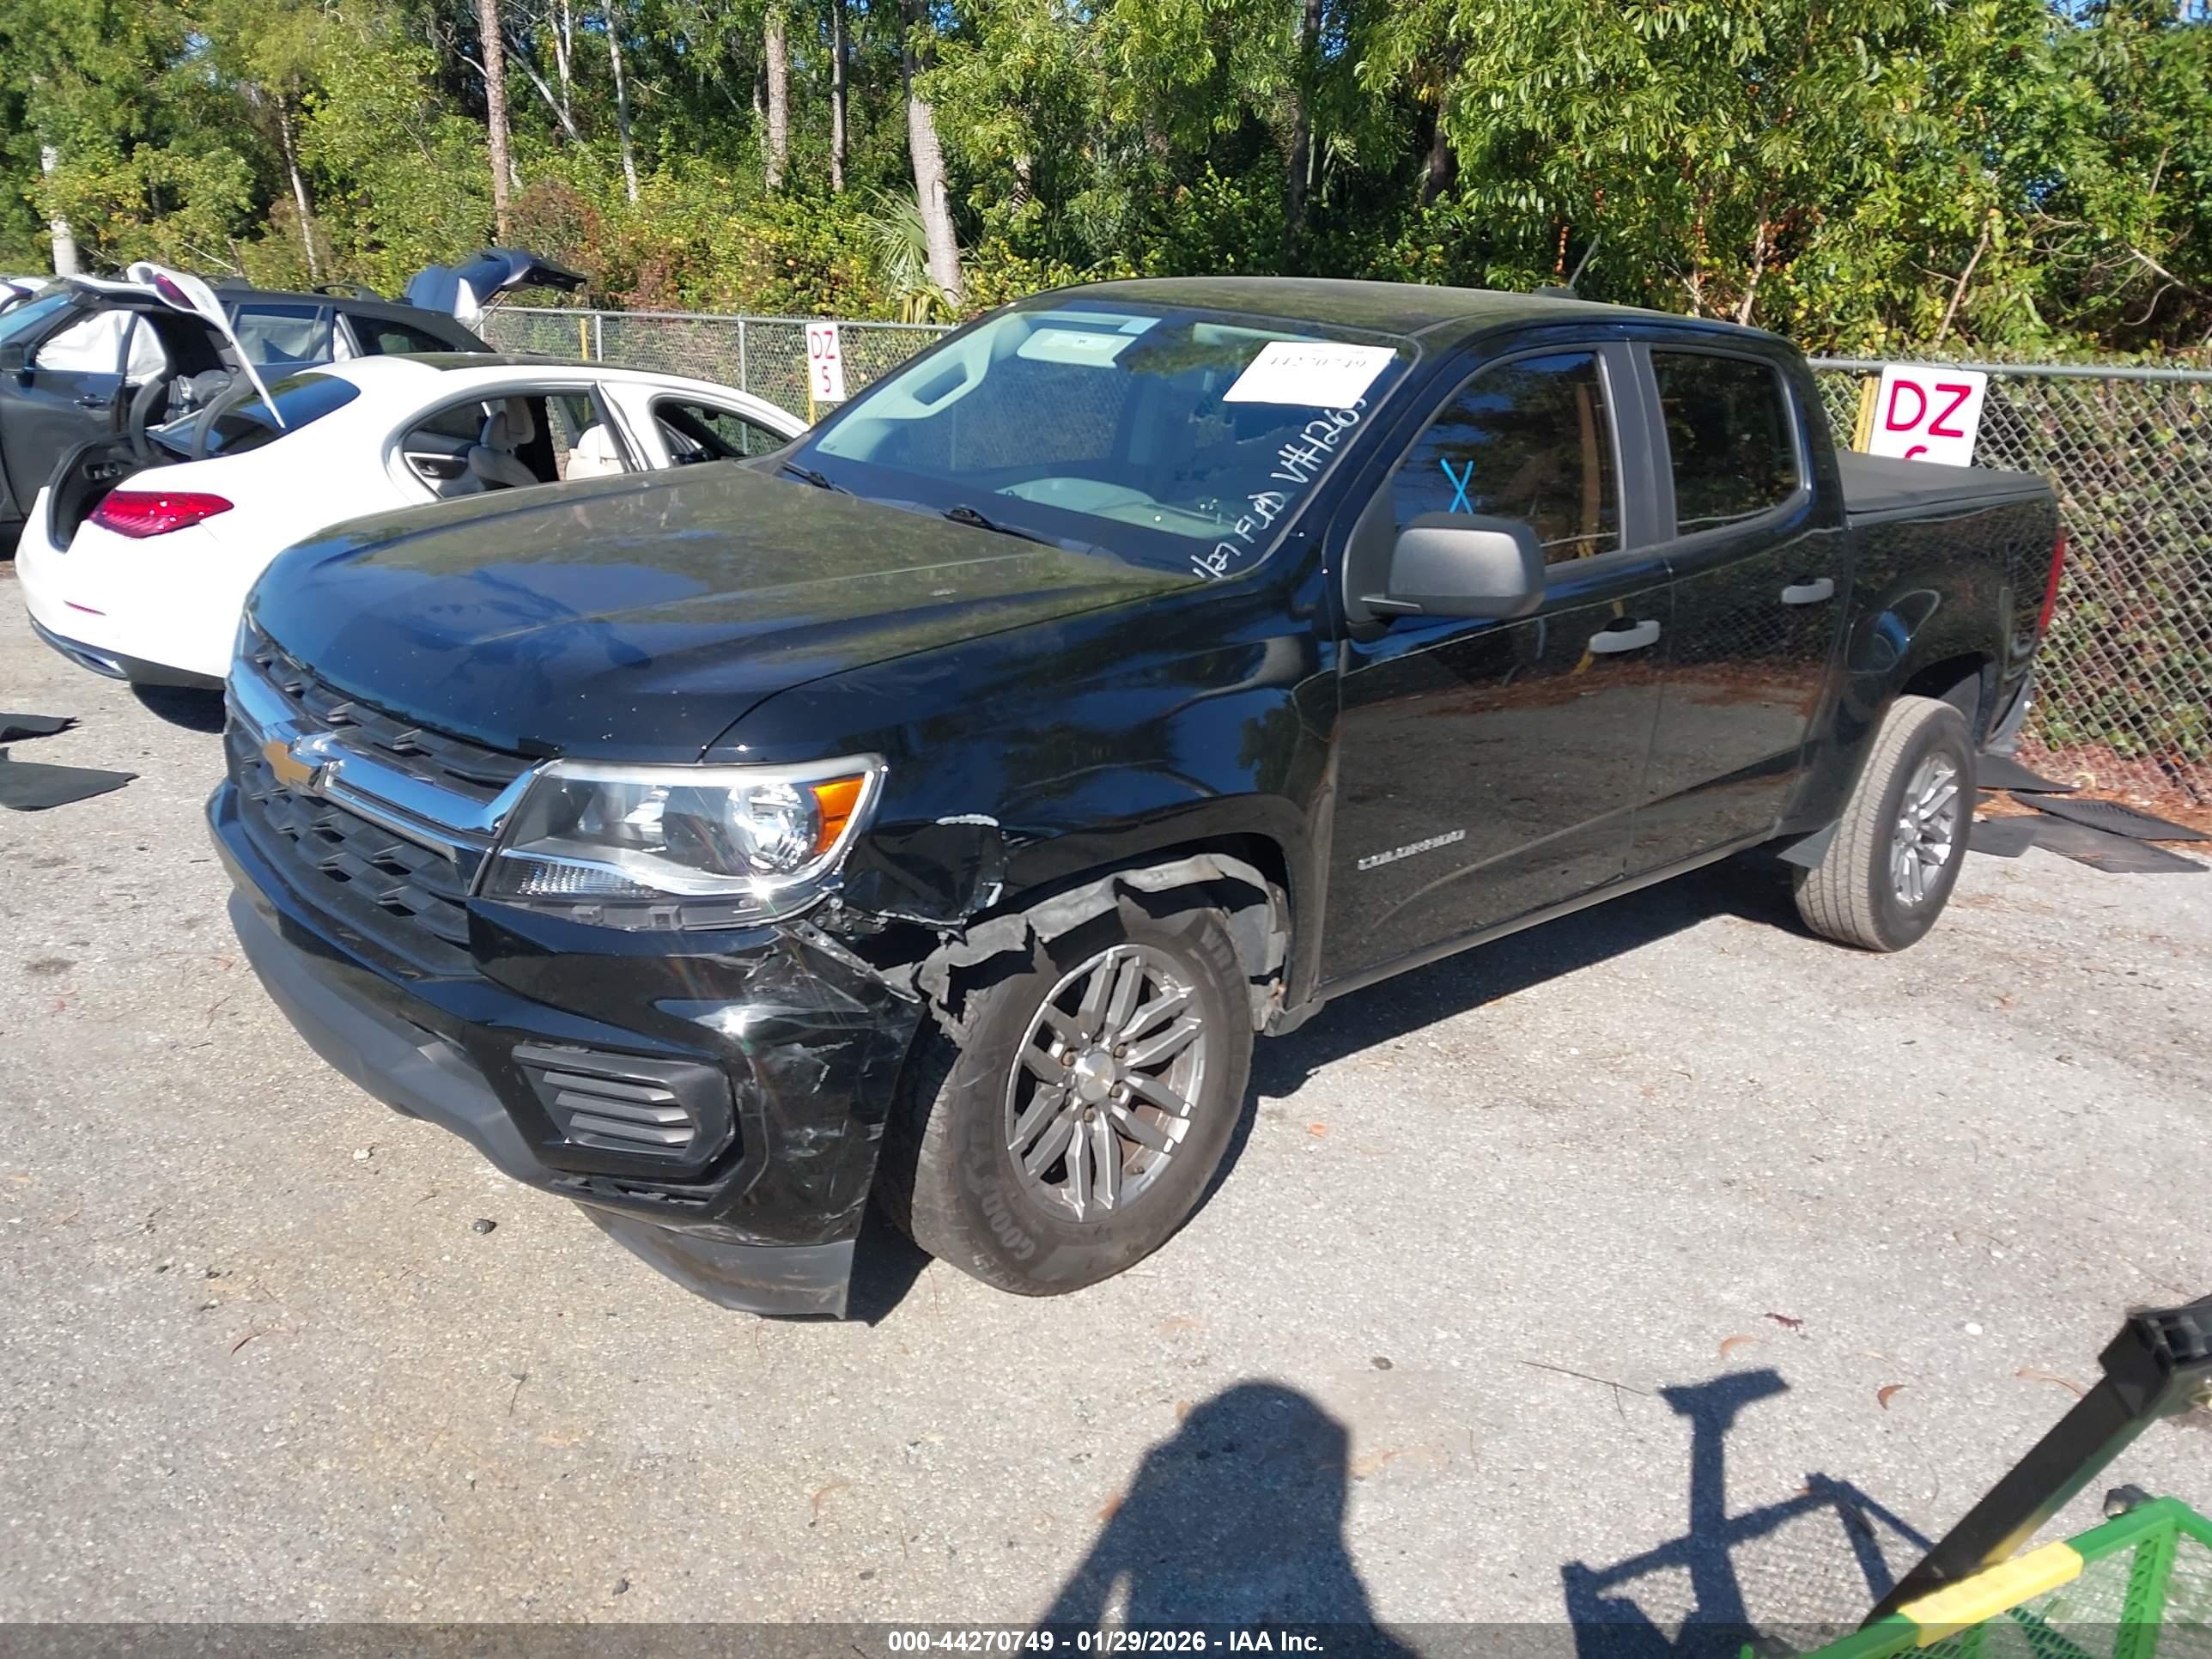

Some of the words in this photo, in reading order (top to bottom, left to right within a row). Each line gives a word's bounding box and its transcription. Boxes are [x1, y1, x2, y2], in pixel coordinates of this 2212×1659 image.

[810, 330, 836, 360] DZ
[821, 365, 832, 393] 5
[1886, 380, 1972, 438] DZ
[1190, 542, 1242, 578] 1/27
[1357, 829, 1467, 872] COLORADO
